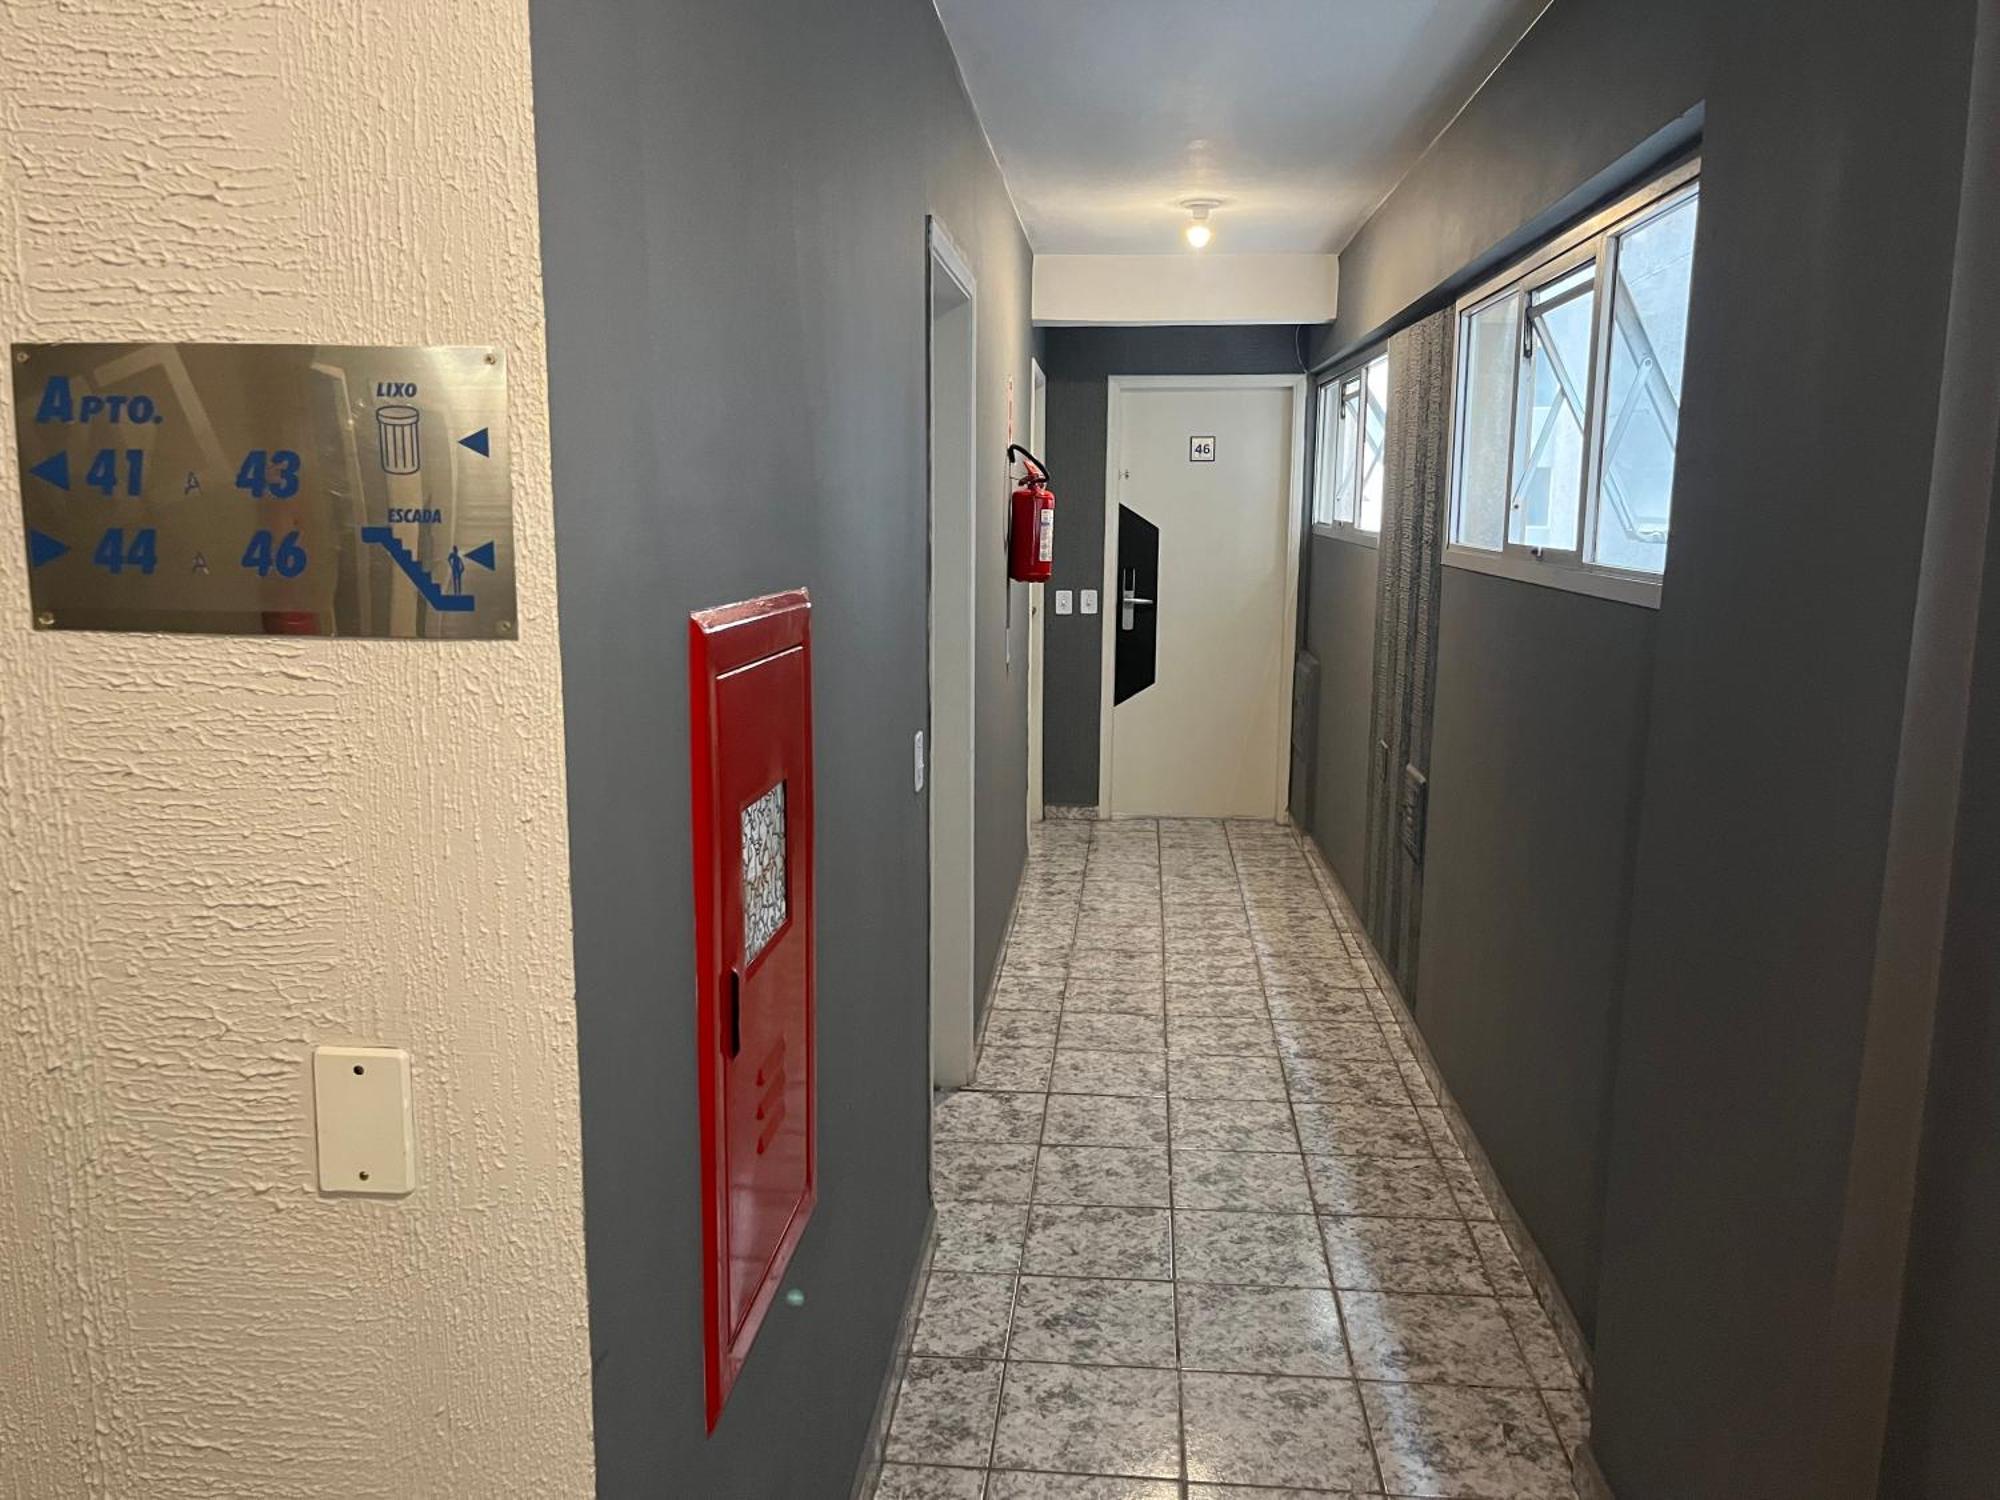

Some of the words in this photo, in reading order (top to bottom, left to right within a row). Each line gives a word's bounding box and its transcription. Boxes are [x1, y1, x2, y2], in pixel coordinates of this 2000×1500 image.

[376, 382, 417, 398] LIXO
[1194, 443, 1210, 454] 46
[86, 449, 144, 497] 41
[236, 450, 300, 498] 43
[387, 508, 442, 524] ESCADA
[94, 528, 158, 575] 44
[241, 530, 307, 577] 46
